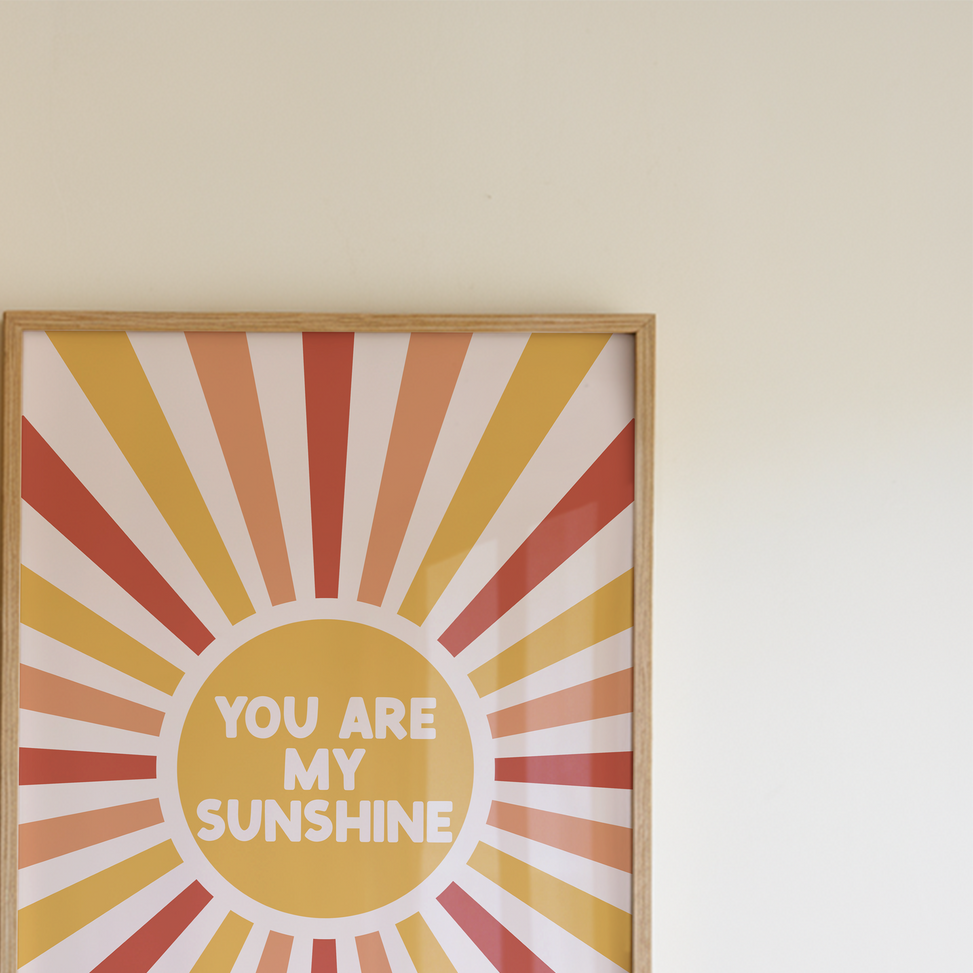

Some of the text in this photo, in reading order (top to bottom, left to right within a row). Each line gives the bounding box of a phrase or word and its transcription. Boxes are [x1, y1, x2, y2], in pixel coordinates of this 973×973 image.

[214, 695, 437, 740] YOU ARE
[283, 747, 367, 791] MY
[196, 798, 454, 843] SUNSHINE
